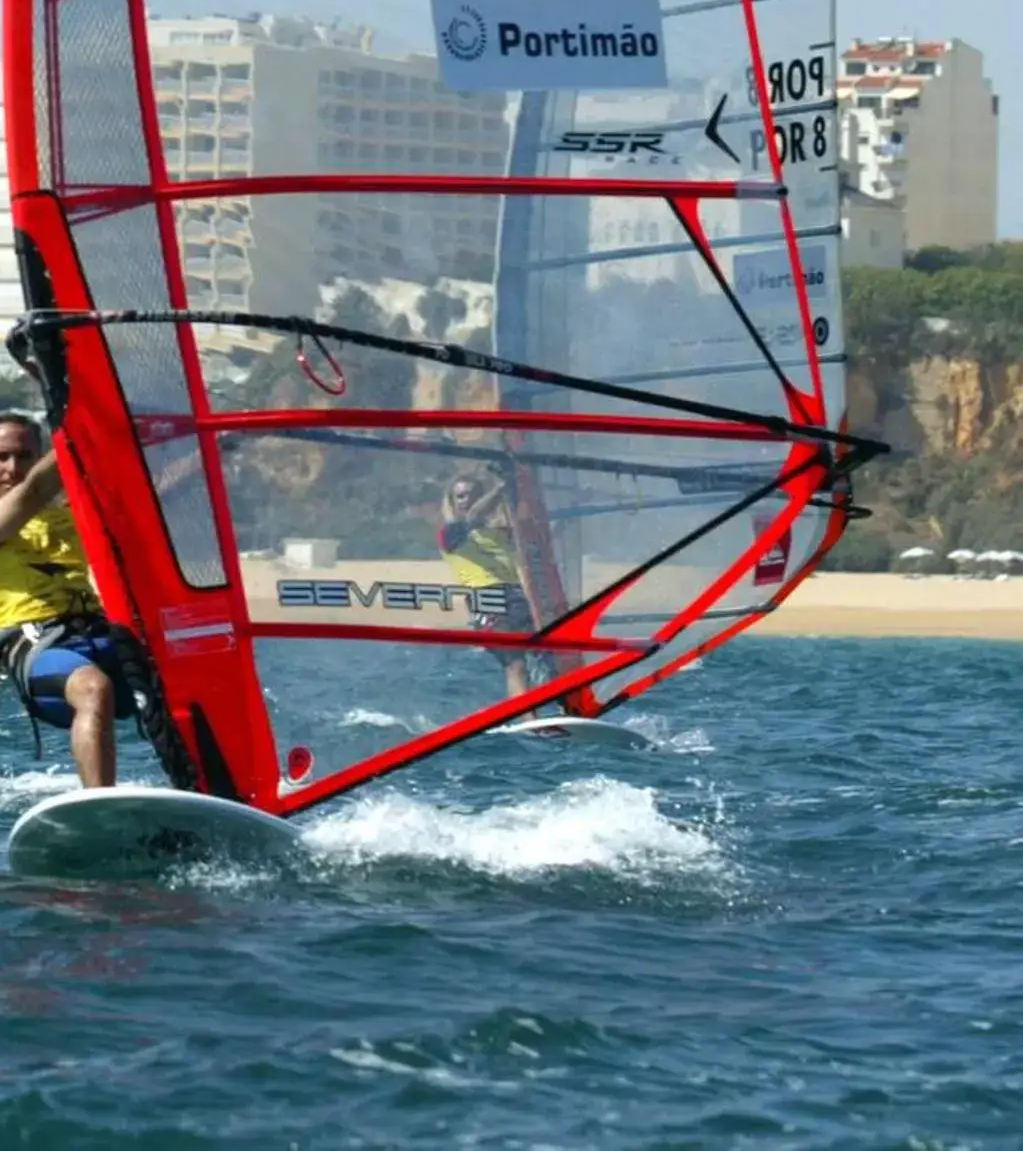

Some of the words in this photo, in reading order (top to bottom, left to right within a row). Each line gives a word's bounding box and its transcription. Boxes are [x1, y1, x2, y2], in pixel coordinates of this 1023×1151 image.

[498, 22, 658, 58] Portimão
[553, 132, 665, 154] SSR
[813, 115, 826, 158] 8
[277, 580, 507, 614] SEVERNE
